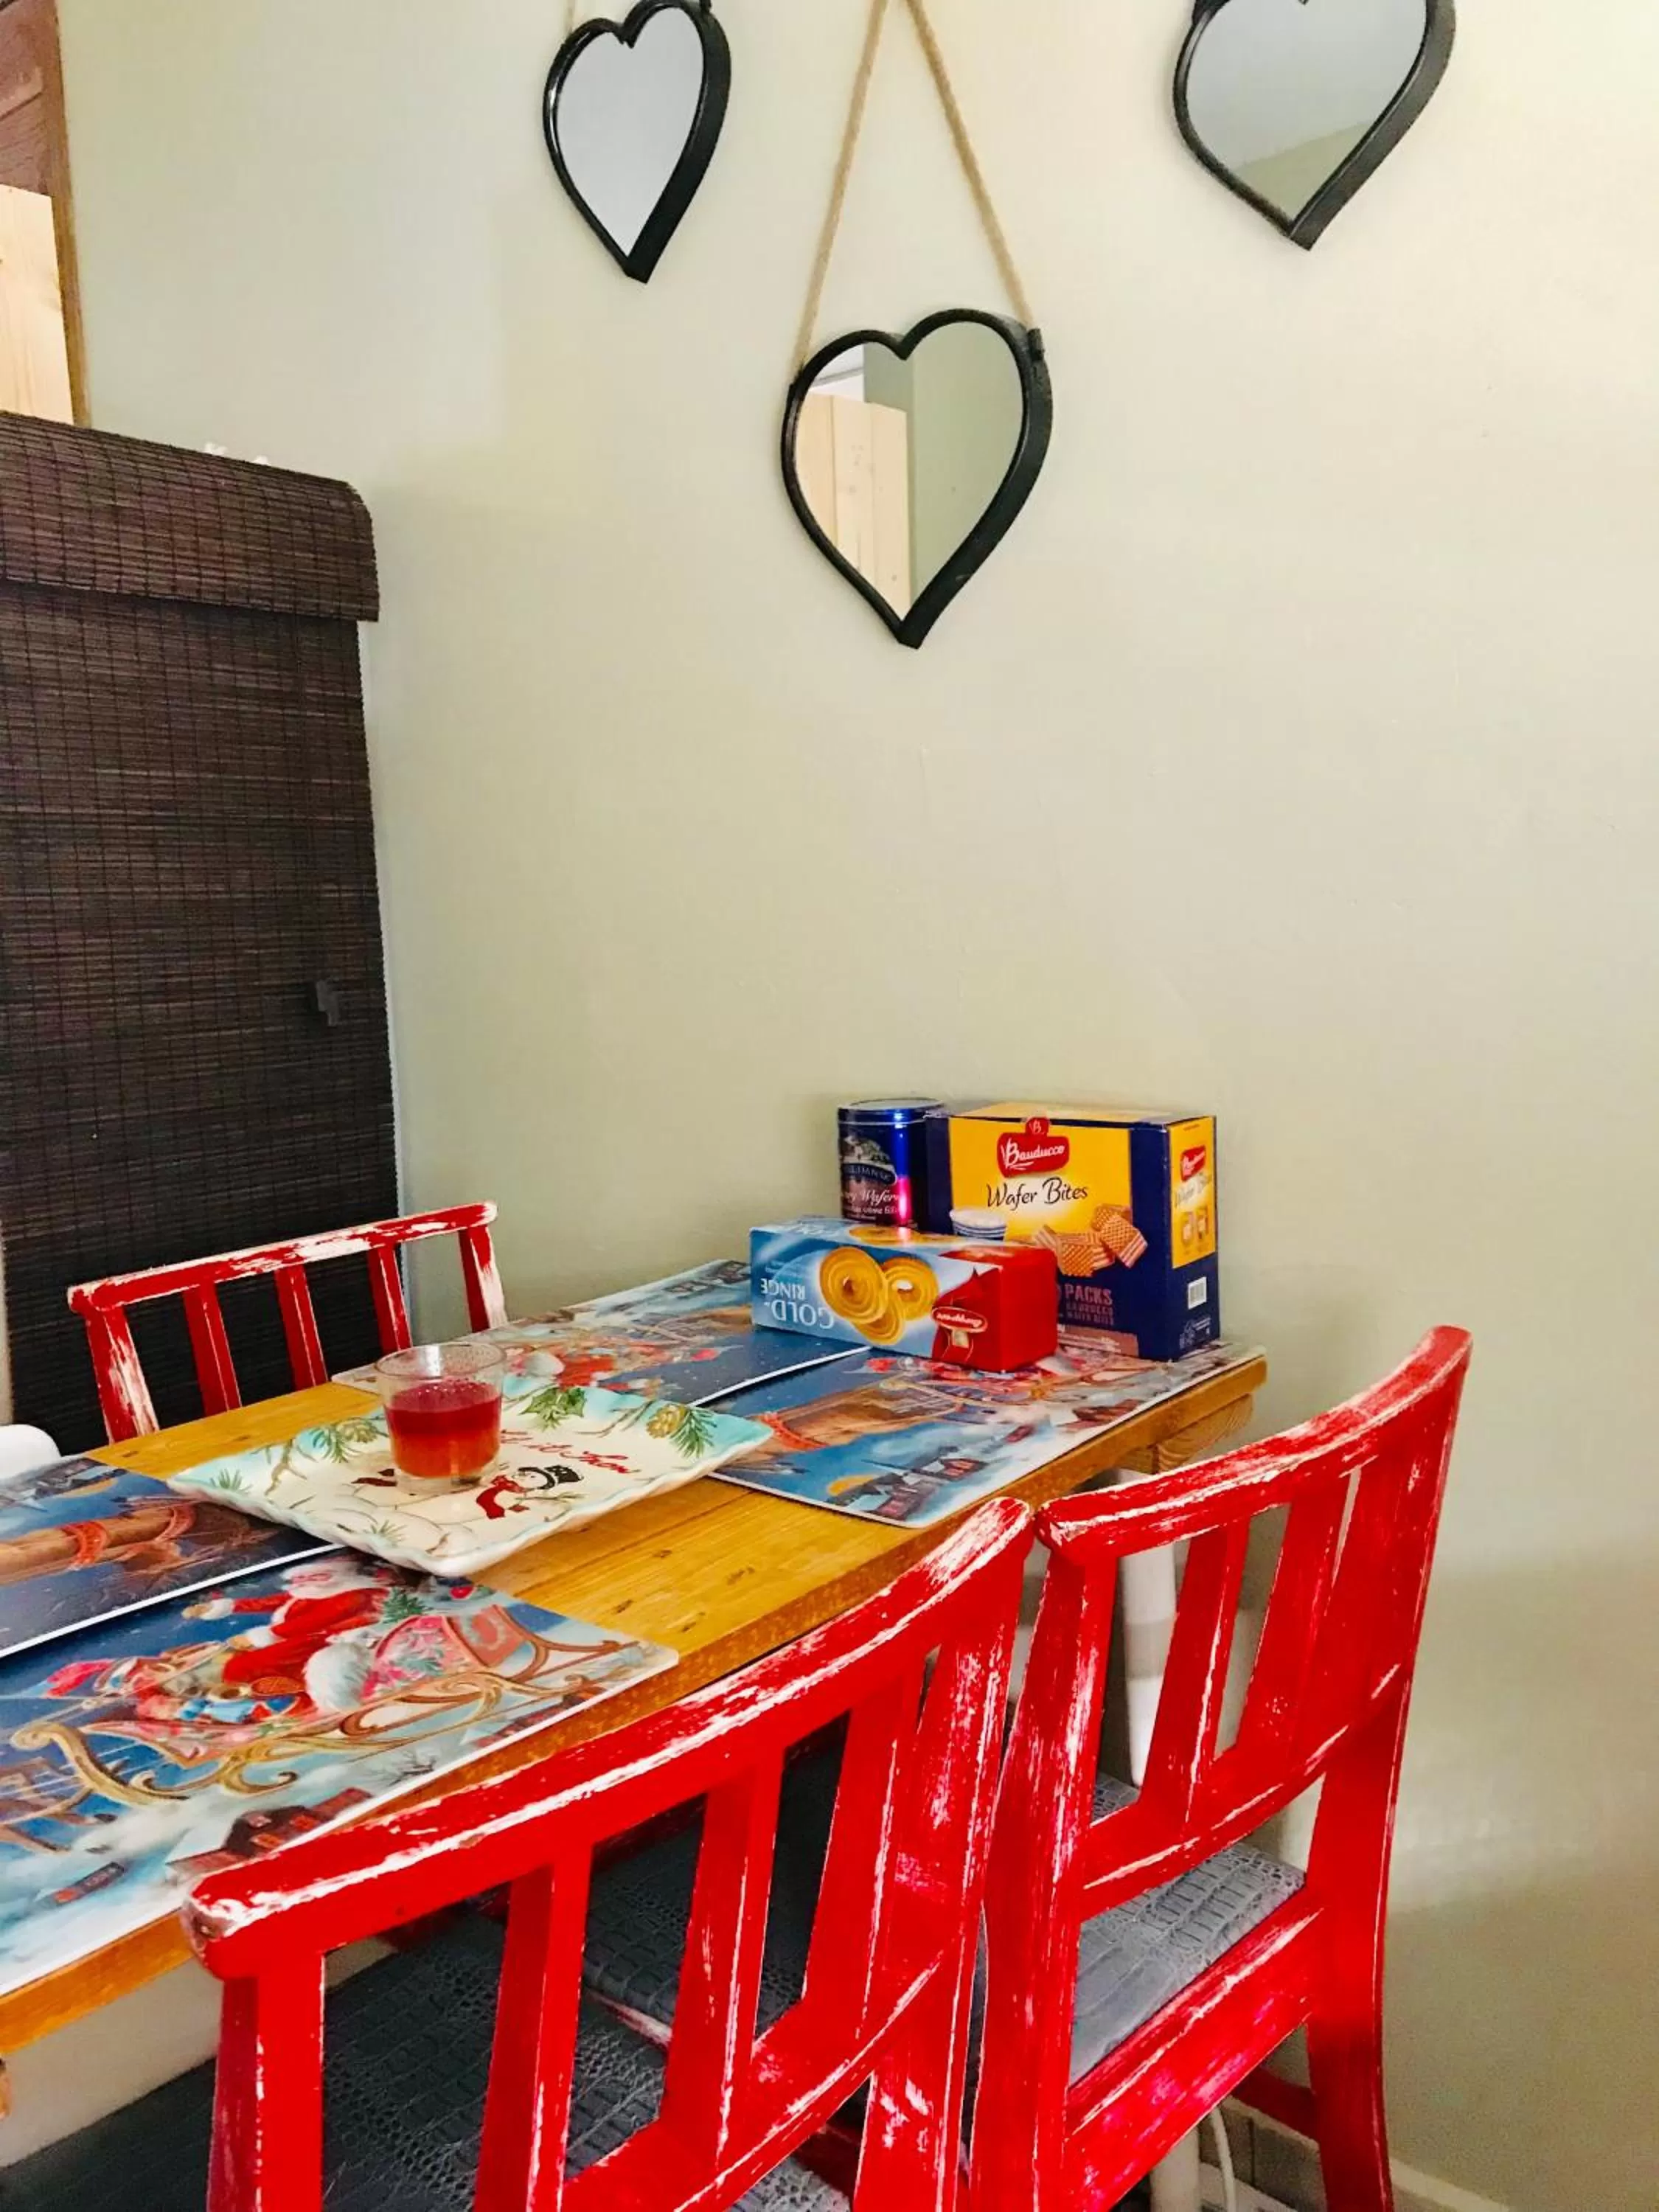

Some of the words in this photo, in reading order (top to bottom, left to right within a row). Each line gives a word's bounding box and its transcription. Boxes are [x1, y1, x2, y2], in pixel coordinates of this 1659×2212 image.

[1001, 1138, 1065, 1169] Bauducco
[987, 1183, 1037, 1211] Wafer
[1042, 1177, 1088, 1204] Bites
[760, 1278, 806, 1301] RINGE
[1064, 1283, 1113, 1306] PACKS
